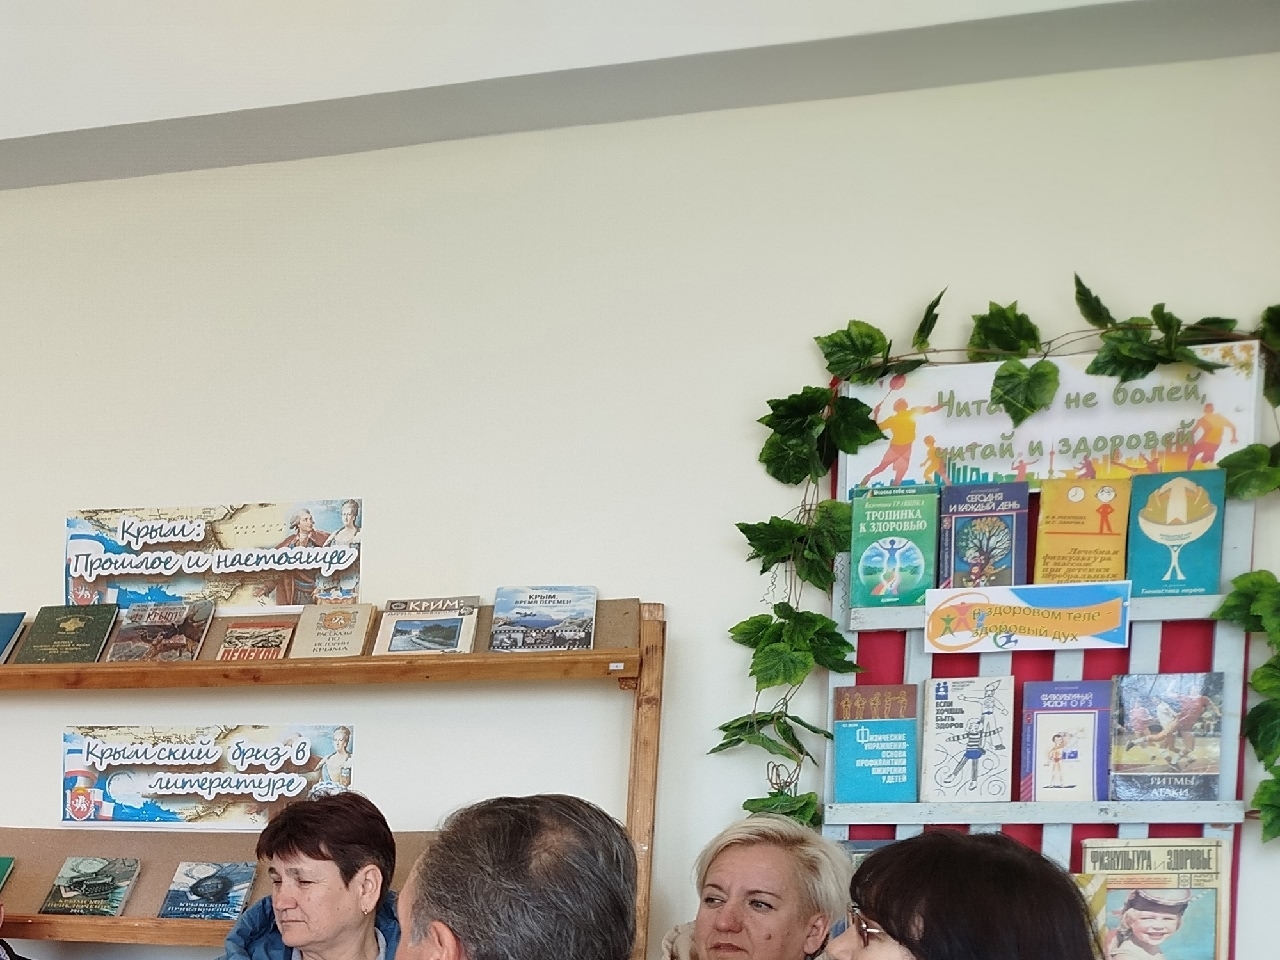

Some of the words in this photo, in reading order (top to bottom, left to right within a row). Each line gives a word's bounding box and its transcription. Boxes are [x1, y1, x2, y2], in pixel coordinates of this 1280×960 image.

[937, 390, 1005, 418] Чита
[1066, 391, 1098, 410] не
[935, 430, 1015, 462] читай
[1029, 442, 1043, 457] и
[1059, 420, 1196, 460] здоровей
[950, 504, 957, 512] И
[958, 501, 996, 512] КАЖДЫЙ
[997, 502, 1021, 511] ДЕНЬ
[966, 493, 1003, 503] СЕГОДНЯ
[865, 509, 922, 521] ТРОПИНКА
[121, 519, 202, 541] Крым:
[859, 522, 866, 532] К
[870, 520, 927, 534] ЗДОРОВЬЮ
[73, 552, 180, 577] Прошлое
[187, 555, 208, 569] и
[215, 549, 354, 572] настоящее
[986, 605, 1061, 621] здоровом
[1067, 611, 1101, 622] теле
[972, 624, 1048, 638] здоровый
[1052, 632, 1079, 643] дух
[85, 740, 218, 767] Крымский
[230, 740, 287, 766] бриз
[294, 742, 307, 760] в
[148, 774, 302, 797] литературе
[1150, 776, 1195, 786] РИТМЫ
[1150, 787, 1189, 797] АТАКИ
[1091, 850, 1152, 870] ФИЗКУЛЬТУРА
[1167, 848, 1212, 870] ЗДОРОВЬЕ
